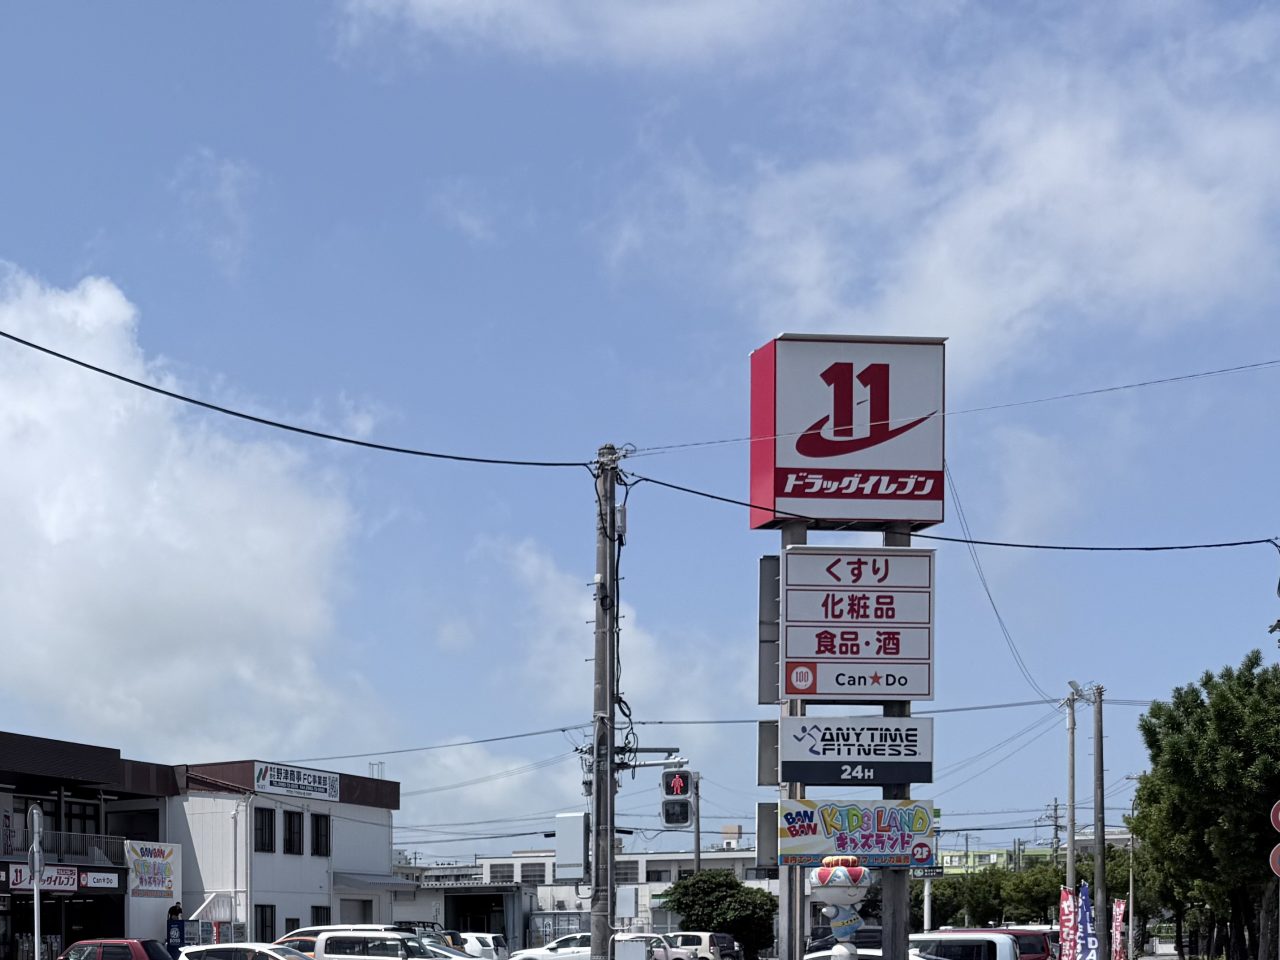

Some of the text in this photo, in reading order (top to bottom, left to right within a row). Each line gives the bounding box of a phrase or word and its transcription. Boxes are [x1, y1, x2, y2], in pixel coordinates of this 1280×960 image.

[783, 472, 934, 495] ドラッグイレブン
[825, 558, 889, 583] くすり
[821, 593, 895, 619] 化粧品
[815, 630, 901, 655] 食品・酒
[820, 727, 918, 743] ANYTIME
[822, 744, 918, 756] FITNESS
[840, 765, 874, 780] 24H
[783, 810, 815, 825] BAN
[821, 806, 930, 835] KIDS LAND
[787, 823, 818, 837] BAN
[835, 832, 914, 850] キッズランド
[913, 847, 929, 860] 2F
